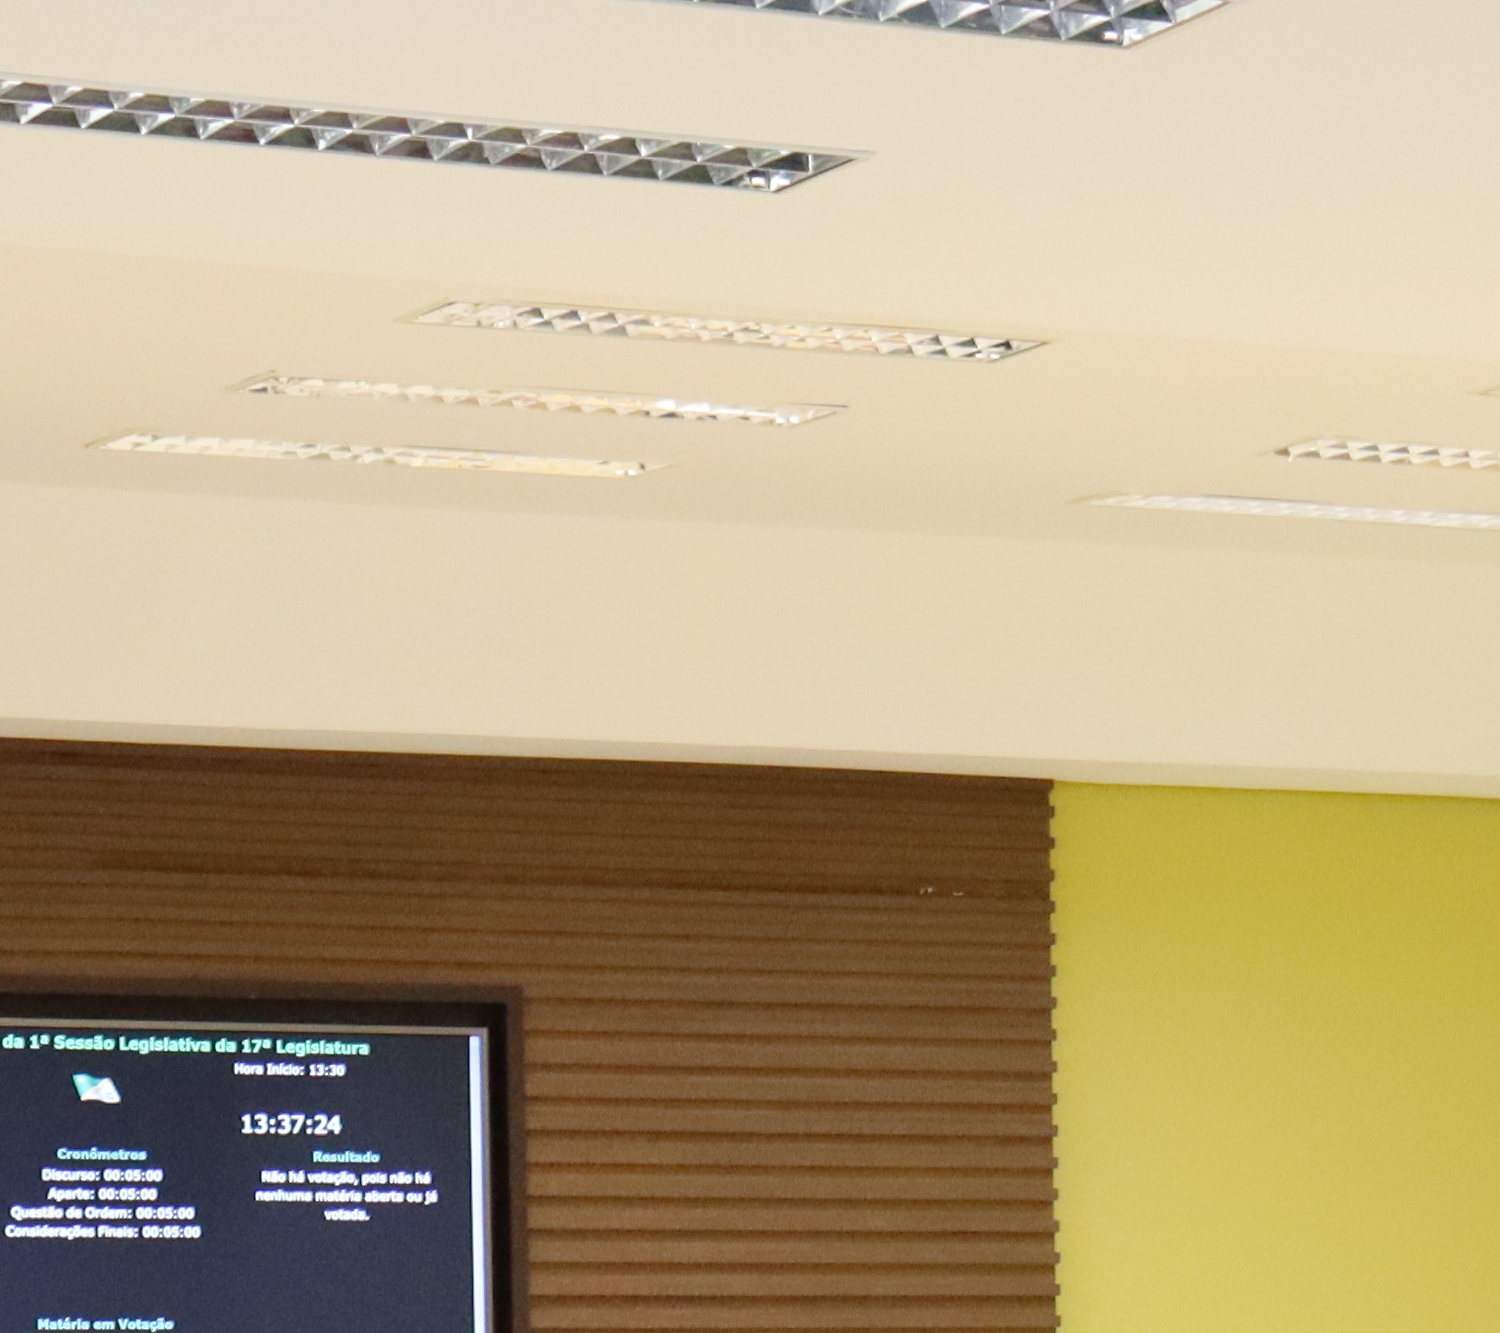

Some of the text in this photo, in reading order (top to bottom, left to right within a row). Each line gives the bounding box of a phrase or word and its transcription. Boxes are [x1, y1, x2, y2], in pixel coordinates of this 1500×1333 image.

[2, 1033, 25, 1048] da
[30, 1033, 50, 1049] 1ª
[54, 1033, 115, 1050] Sessão
[119, 1036, 211, 1054] Legislativa
[215, 1037, 237, 1052] da
[242, 1038, 272, 1053] 17ª
[276, 1039, 370, 1056] Legislatura
[234, 1060, 346, 1076] Hora Início: 13:30
[242, 1111, 342, 1135] 13:37:24
[57, 1147, 147, 1160] Cronômetros
[313, 1150, 380, 1162] Resultado
[42, 1167, 163, 1182] Discurso: 00:05:00
[261, 1168, 432, 1186] Não há votação, pois não há
[48, 1186, 158, 1202] Aparte: 00:05:00
[255, 1188, 438, 1205] nenhuma matéria aberta ou já
[10, 1204, 195, 1220] Questão de Ordem: 00:05:00
[324, 1207, 370, 1221] votada.
[5, 1223, 202, 1240] Considerações Finais: 00:05:00
[37, 1317, 175, 1332] Matéria em Votação
